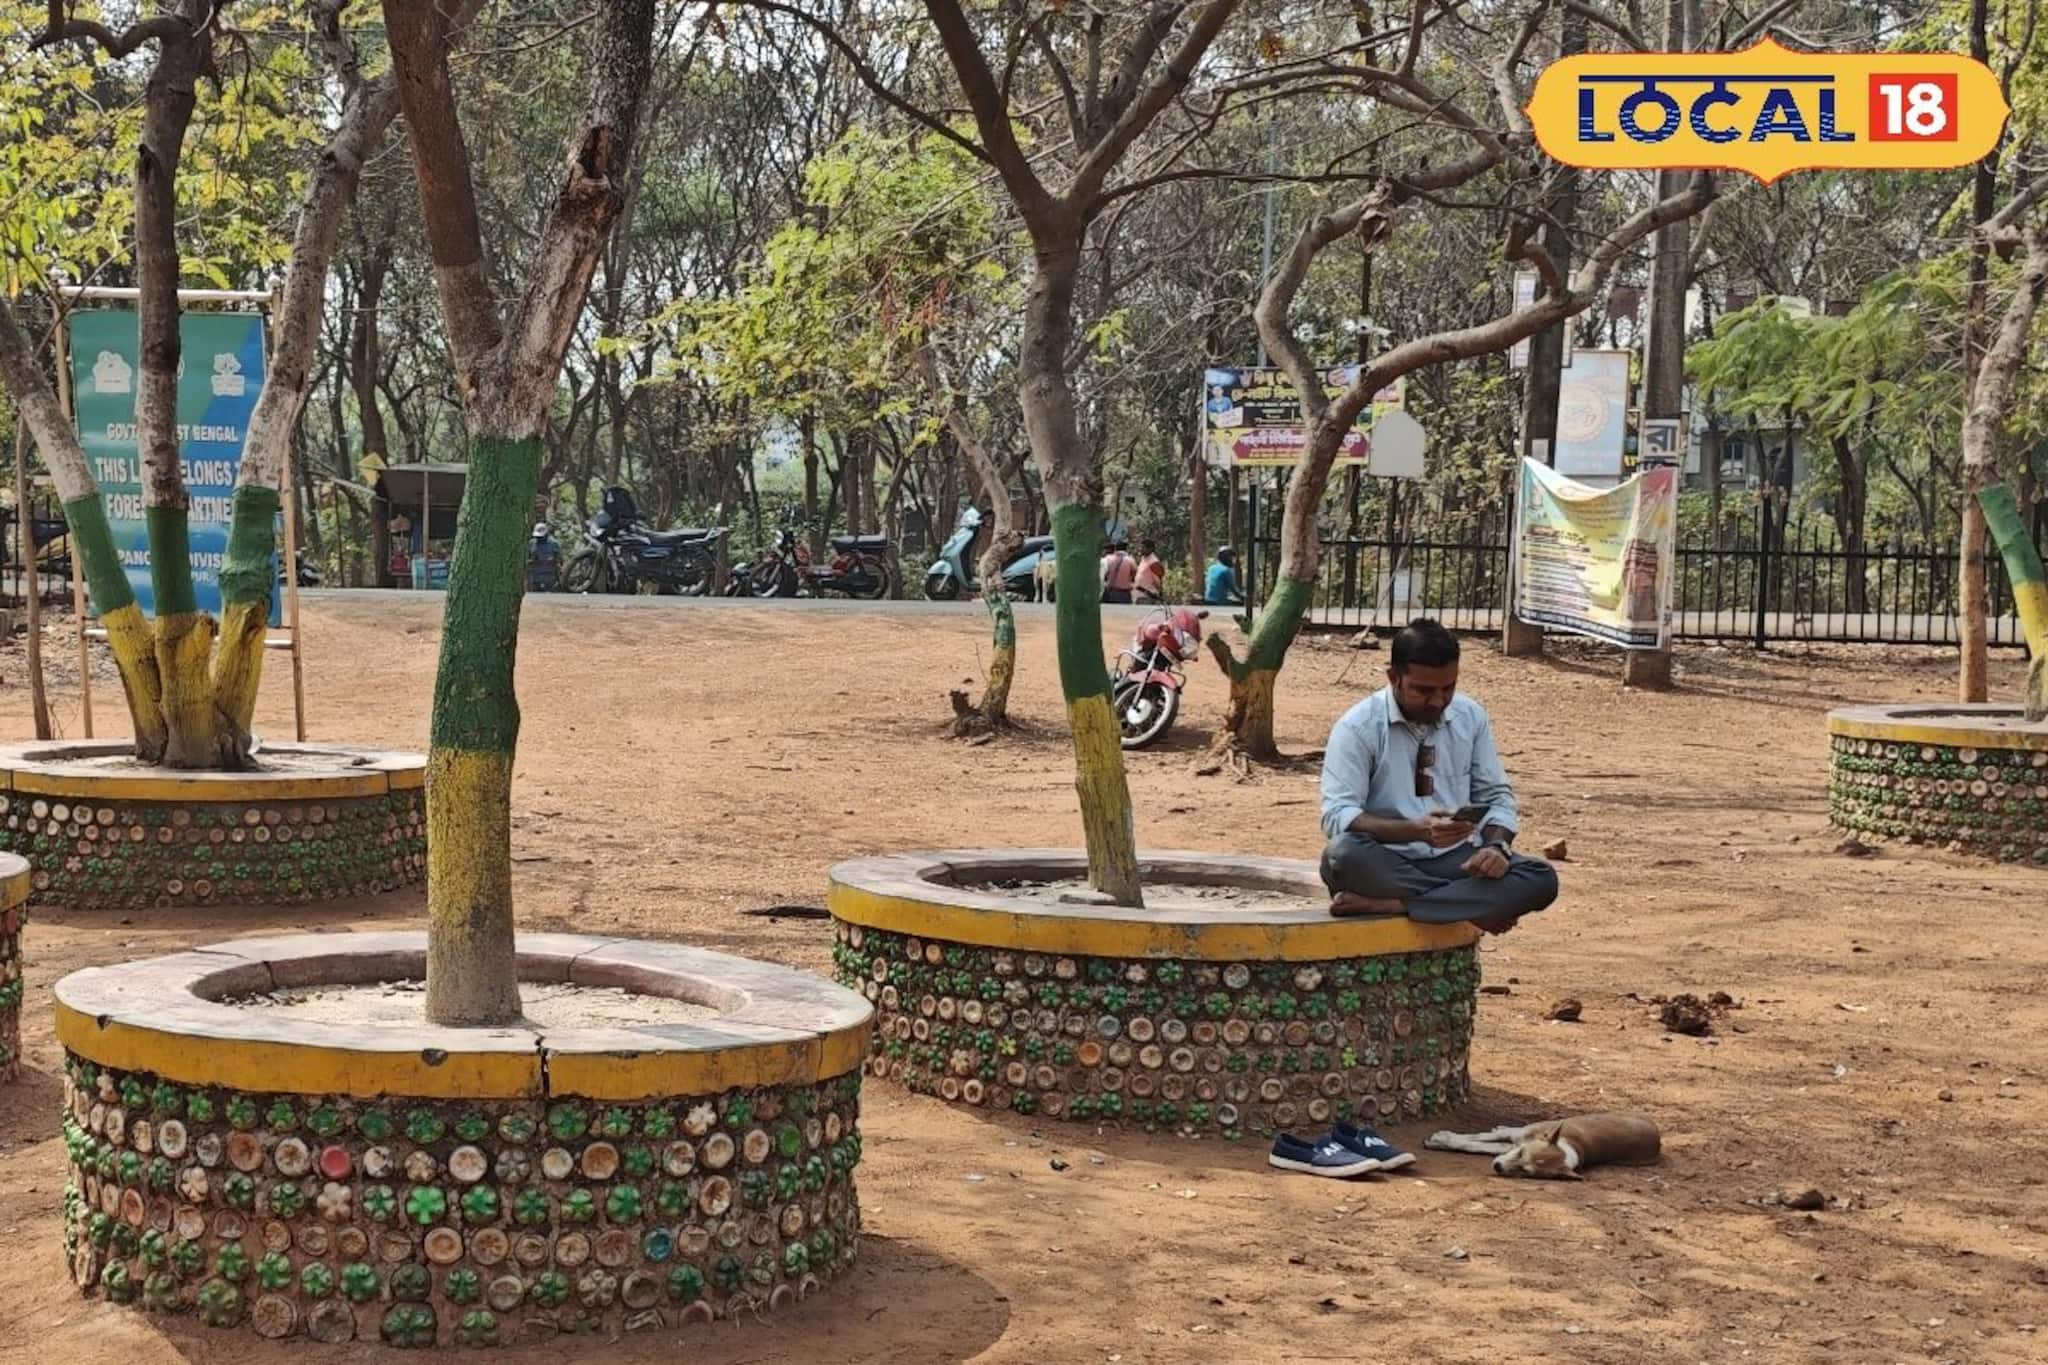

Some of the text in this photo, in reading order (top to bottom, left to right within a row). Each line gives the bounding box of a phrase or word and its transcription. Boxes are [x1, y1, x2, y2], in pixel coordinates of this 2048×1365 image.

[192, 425, 239, 442] BENGAL
[95, 457, 127, 482] THIS
[180, 459, 232, 486] ELONGS
[105, 493, 147, 520] FORE
